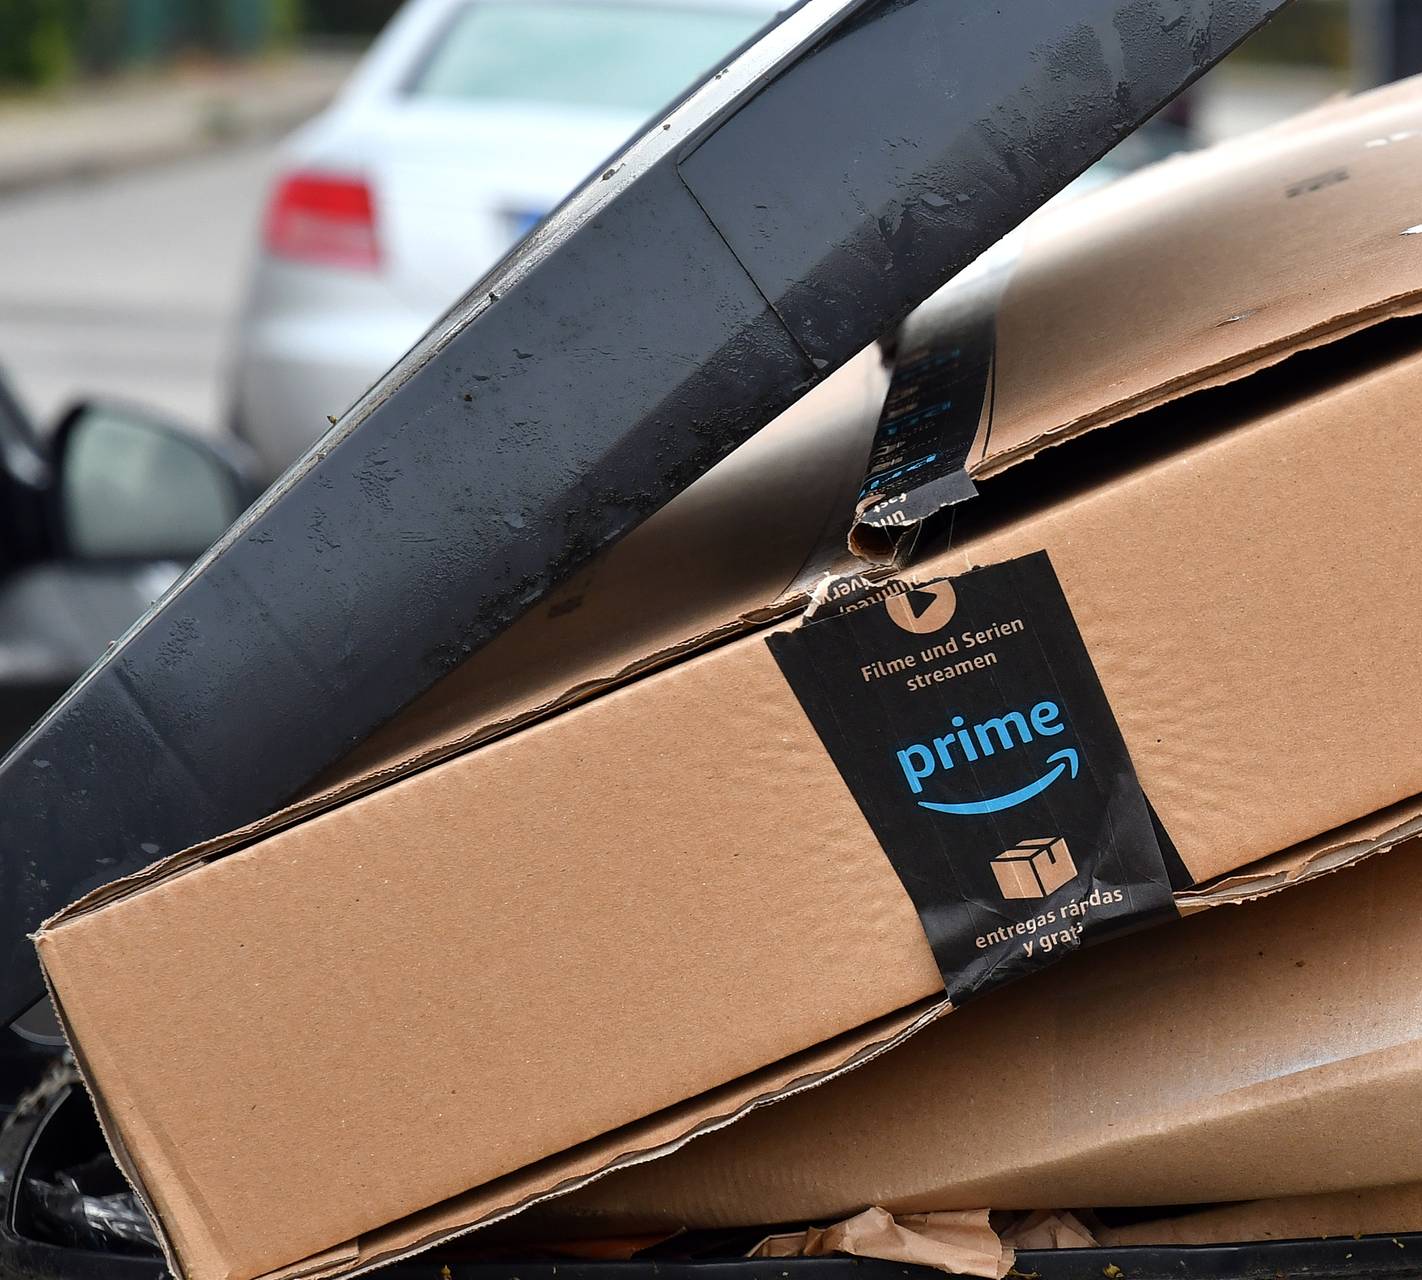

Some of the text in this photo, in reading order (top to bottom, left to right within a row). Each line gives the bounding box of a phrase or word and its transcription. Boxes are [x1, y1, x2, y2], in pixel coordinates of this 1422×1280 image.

[861, 618, 1025, 683] Filme und Serien
[906, 652, 998, 692] streamen
[896, 700, 1065, 794] prime
[975, 910, 1056, 949] entregas
[1022, 939, 1034, 958] y
